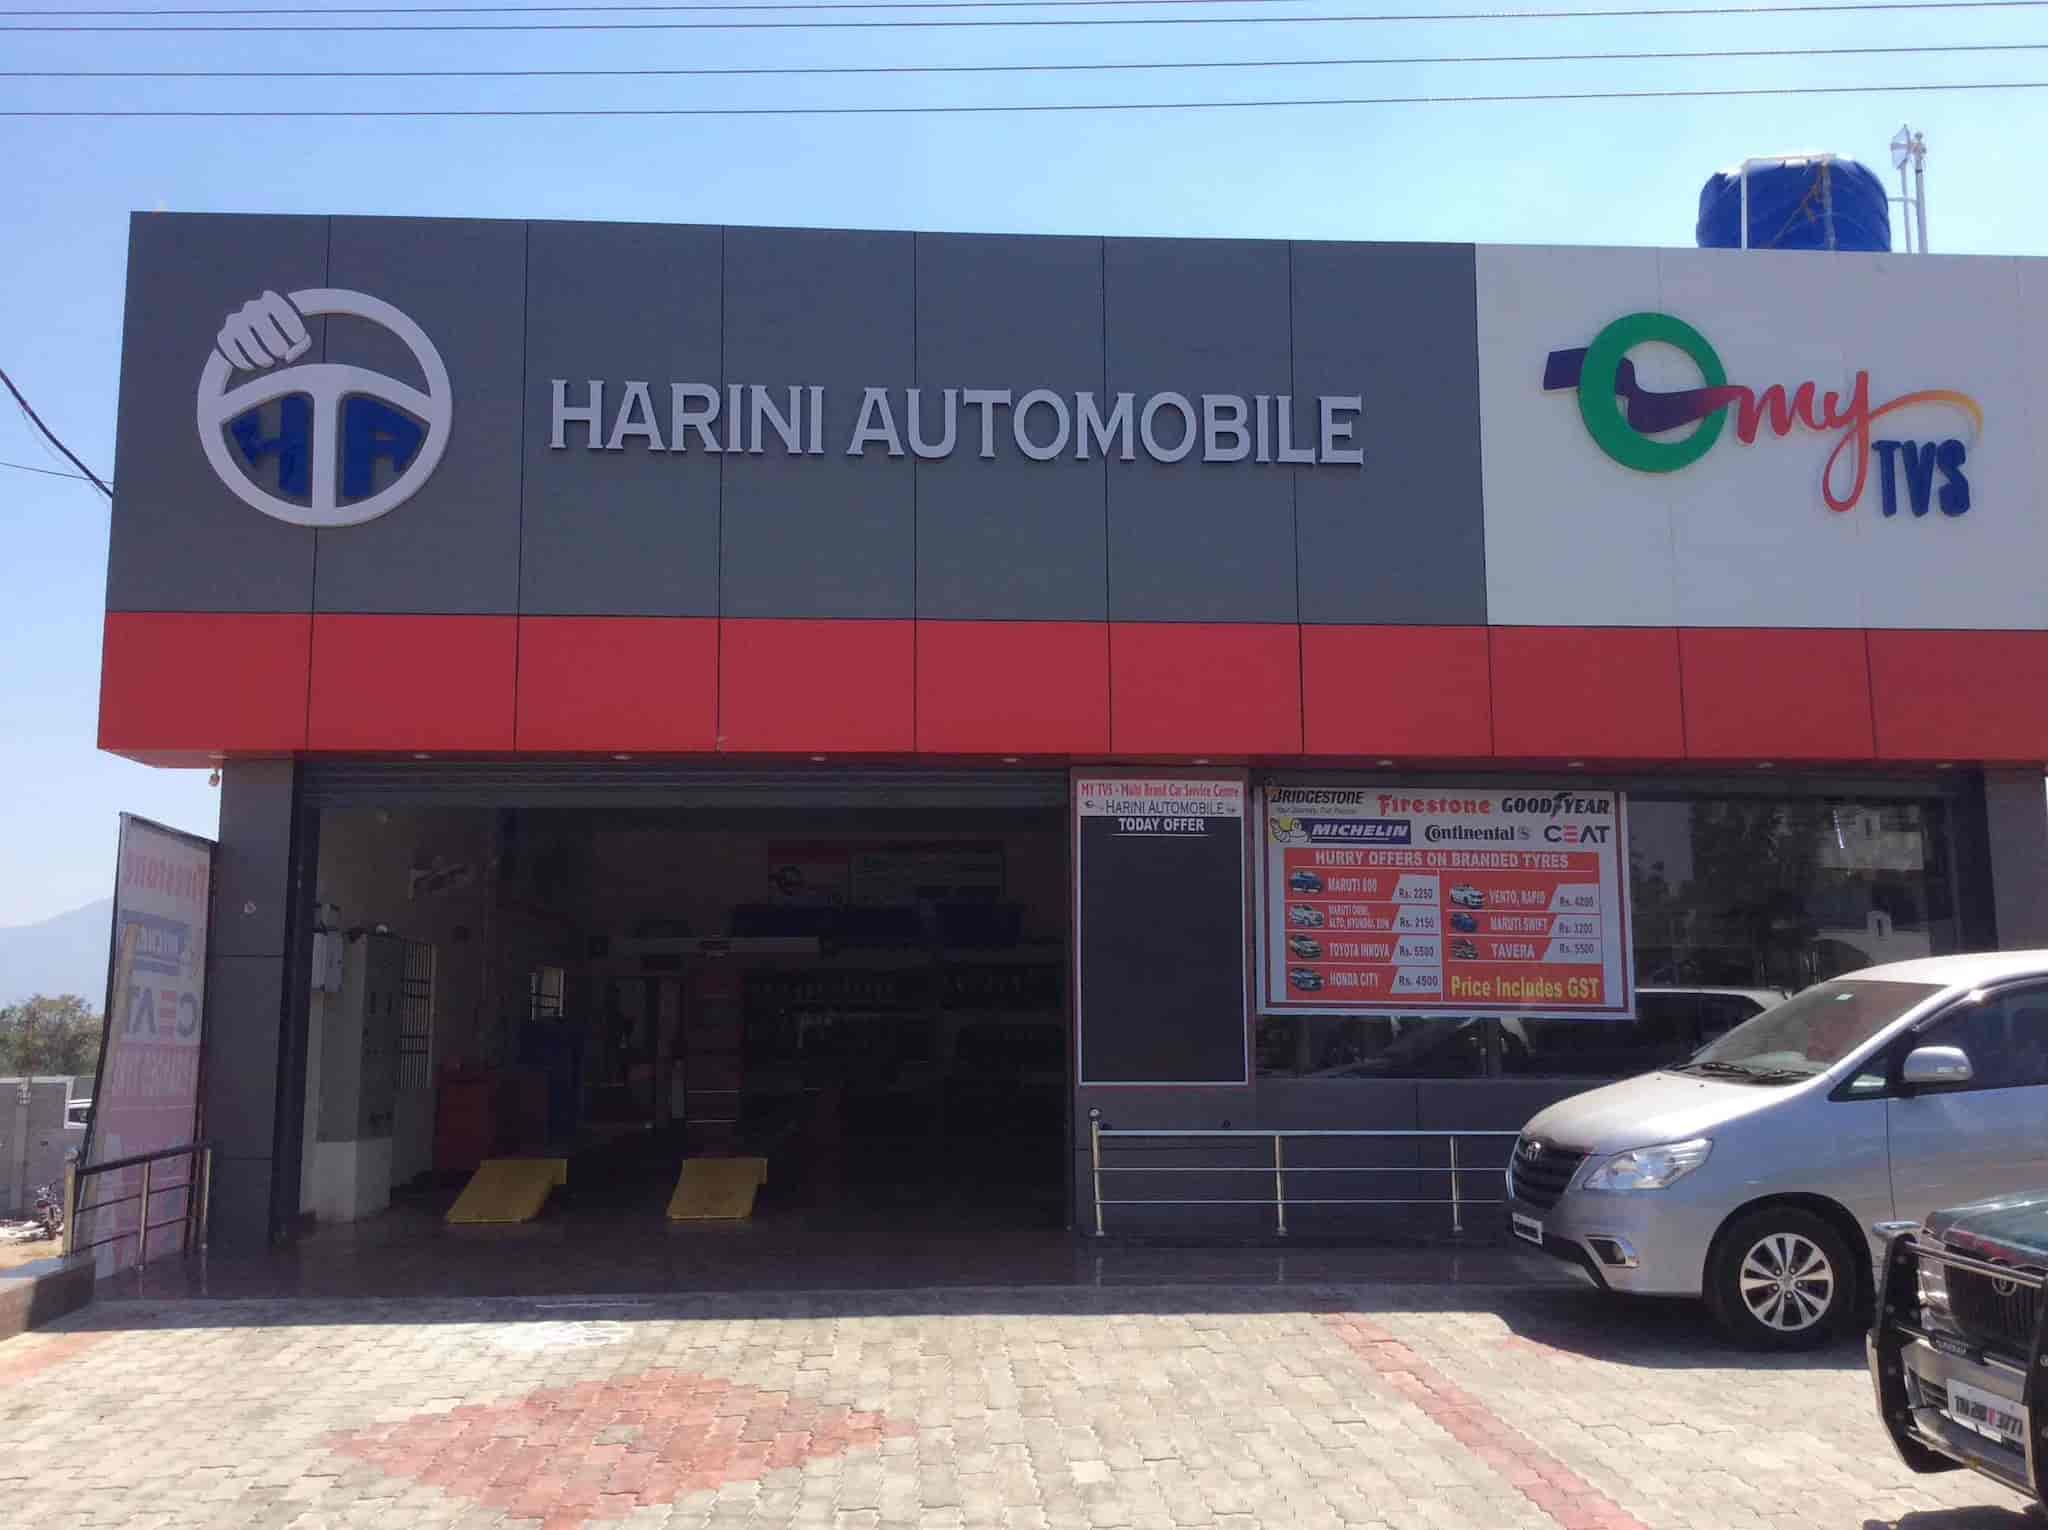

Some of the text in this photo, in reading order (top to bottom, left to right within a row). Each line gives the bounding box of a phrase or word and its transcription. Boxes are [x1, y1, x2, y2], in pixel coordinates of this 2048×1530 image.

[548, 379, 1364, 464] HARINI AUTOMOBILE
[1738, 370, 1869, 512] my
[1872, 439, 1971, 517] TVS
[1271, 788, 1364, 805] BRIDGESTONE
[1376, 794, 1490, 816] Firestone
[1501, 792, 1610, 816] GOODYEAR
[1105, 800, 1225, 815] HARINI AUTOMOBILE
[1118, 817, 1205, 832] TODAY OFFER
[1311, 824, 1409, 837] MICHELIN
[1425, 825, 1514, 842] Continental
[1544, 825, 1610, 844] CEAT
[1315, 851, 1569, 869] HURRY OFFERS ON BRANDED TYRES
[1327, 878, 1362, 893] MARUTI
[1329, 943, 1391, 958] TOYOTA INNOVA
[1490, 943, 1536, 959] TAVERA
[1329, 972, 1359, 986] HONDA
[1451, 975, 1600, 999] Price Includes GST
